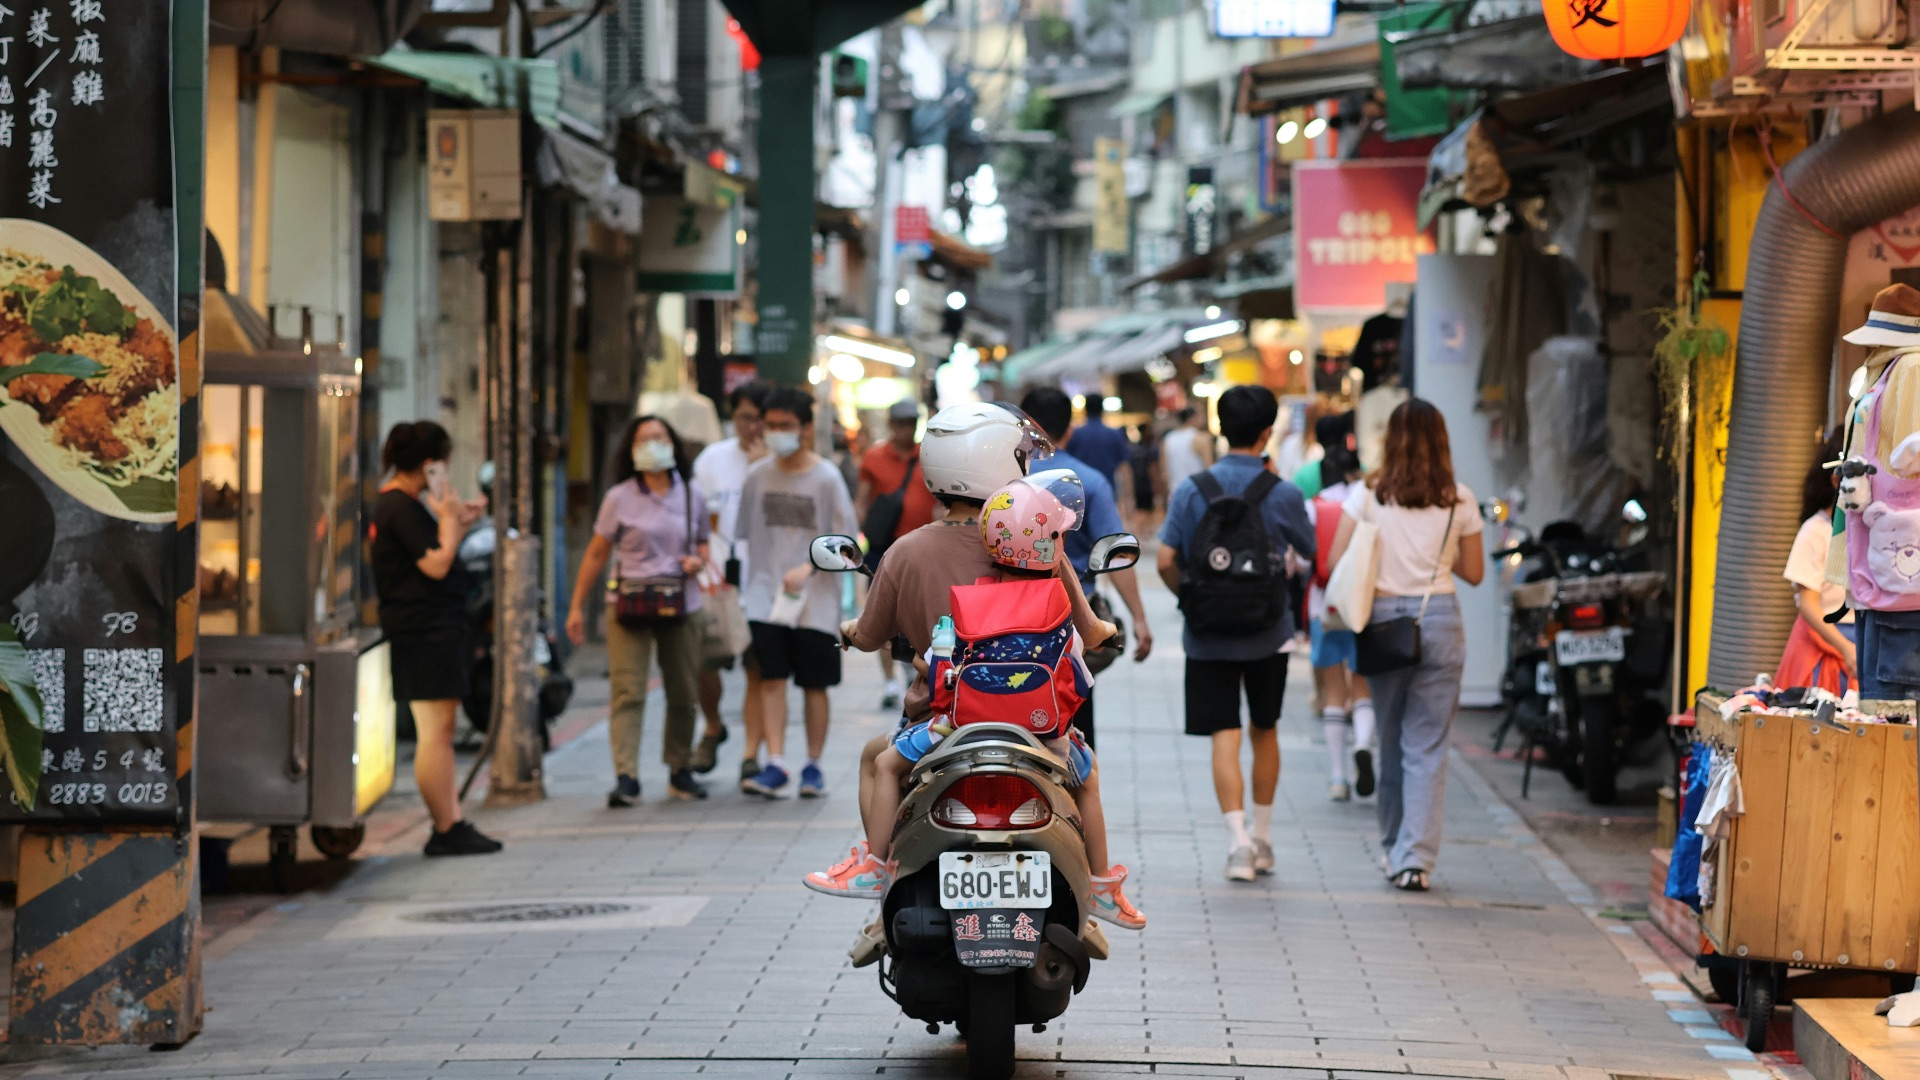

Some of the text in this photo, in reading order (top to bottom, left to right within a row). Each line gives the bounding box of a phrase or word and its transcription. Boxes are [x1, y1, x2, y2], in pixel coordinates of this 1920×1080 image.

[102, 611, 138, 637] FB
[50, 782, 167, 804] 2883 0013
[944, 870, 1048, 898] 680-EWJ
[955, 912, 1040, 941] 進 鑫
